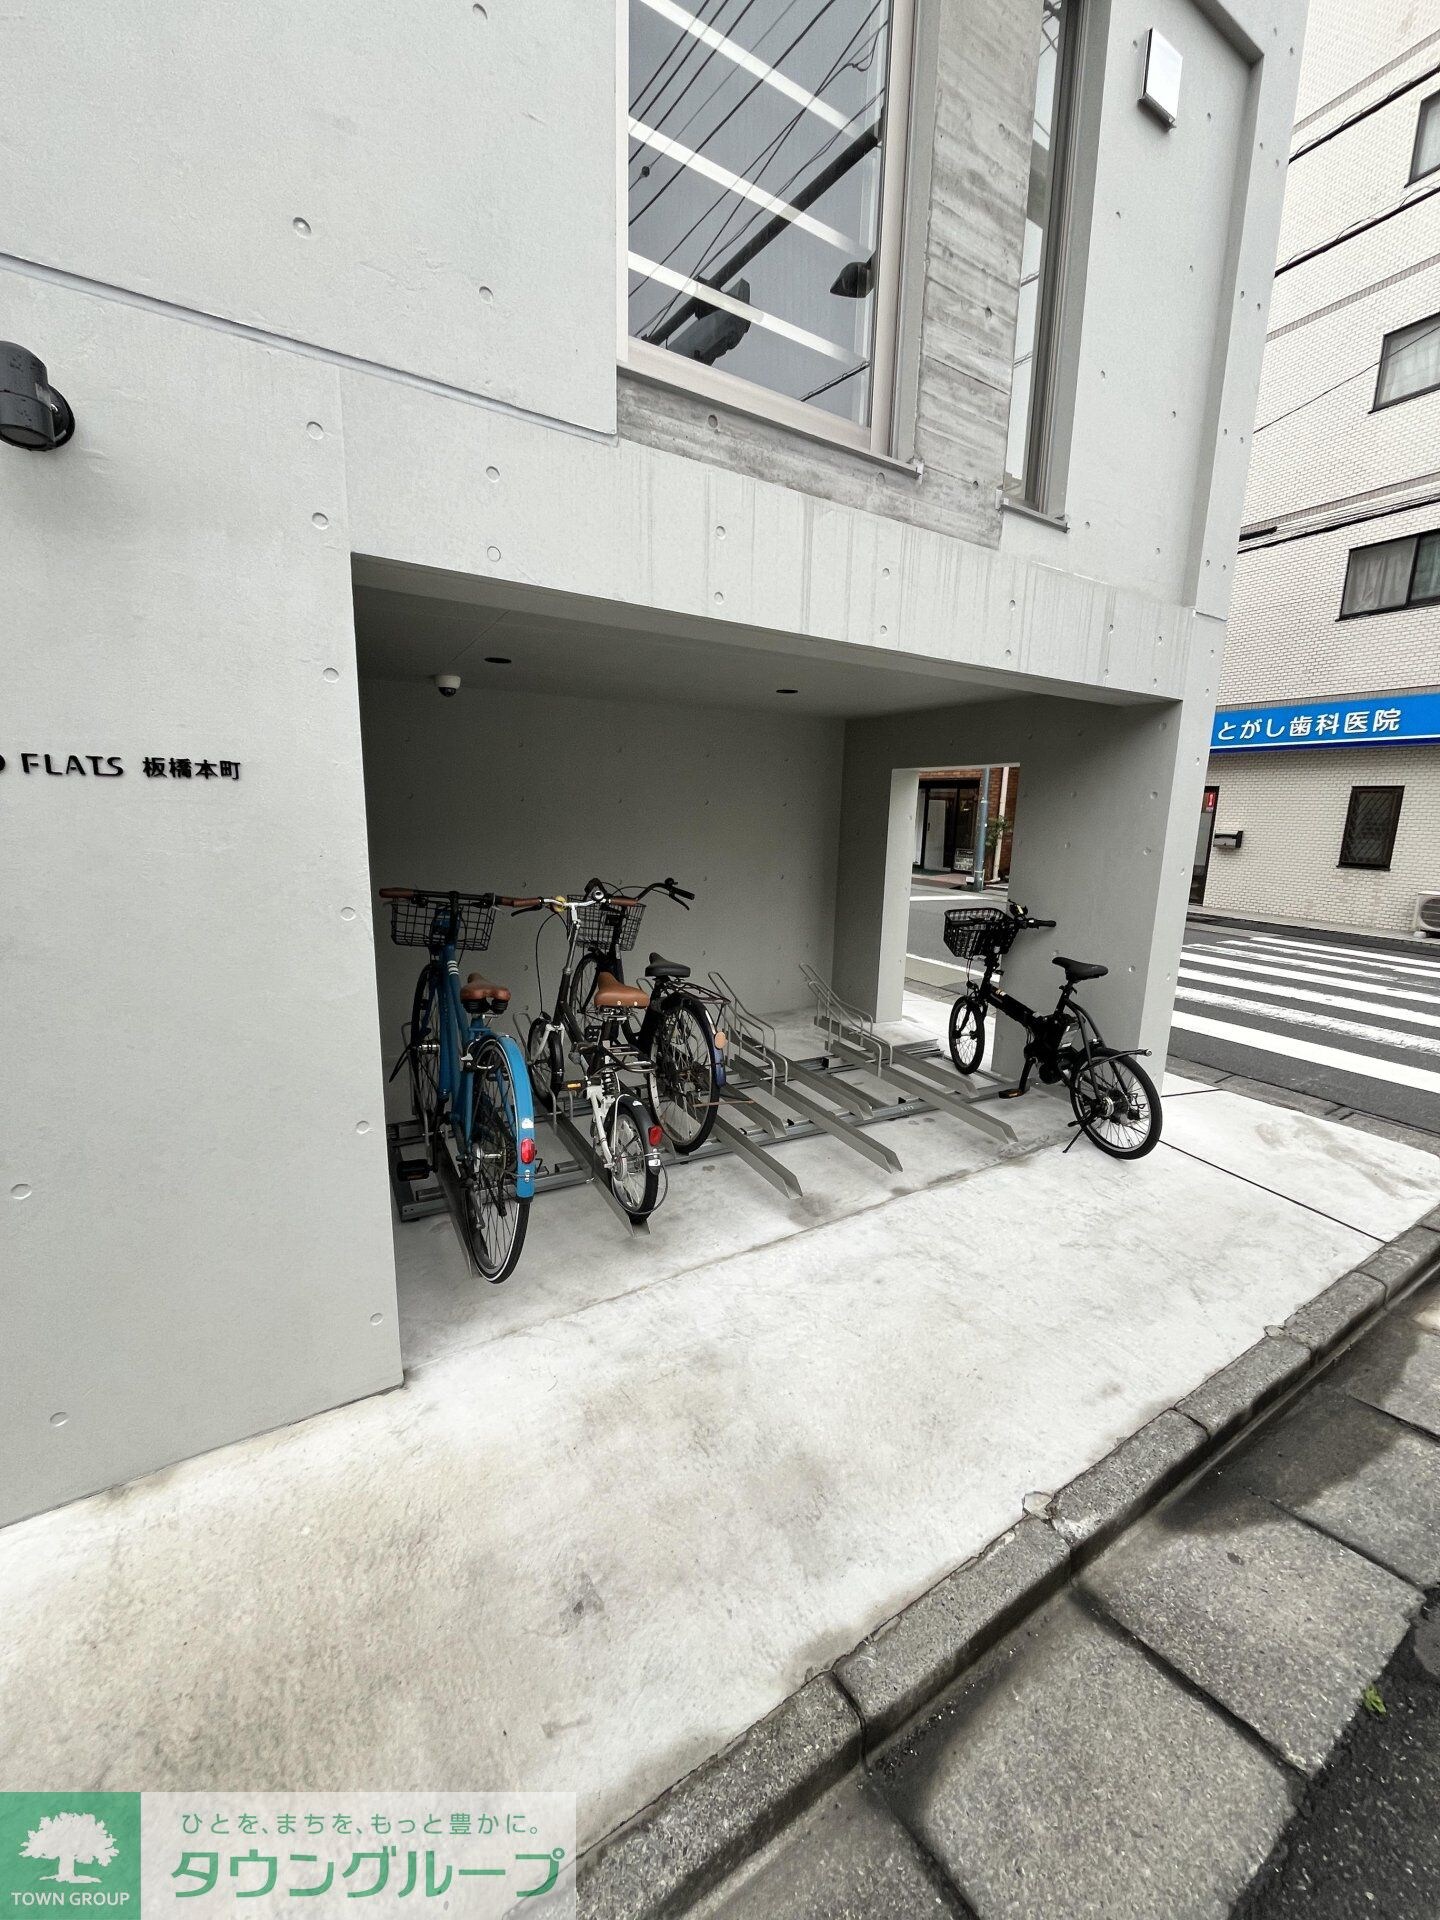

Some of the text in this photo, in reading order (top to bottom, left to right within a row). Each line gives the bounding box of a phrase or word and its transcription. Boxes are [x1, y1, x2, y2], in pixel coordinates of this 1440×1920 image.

[1217, 707, 1402, 741] とがし歯科医院
[20, 752, 124, 778] FLATS
[142, 756, 241, 781] 板橋本町
